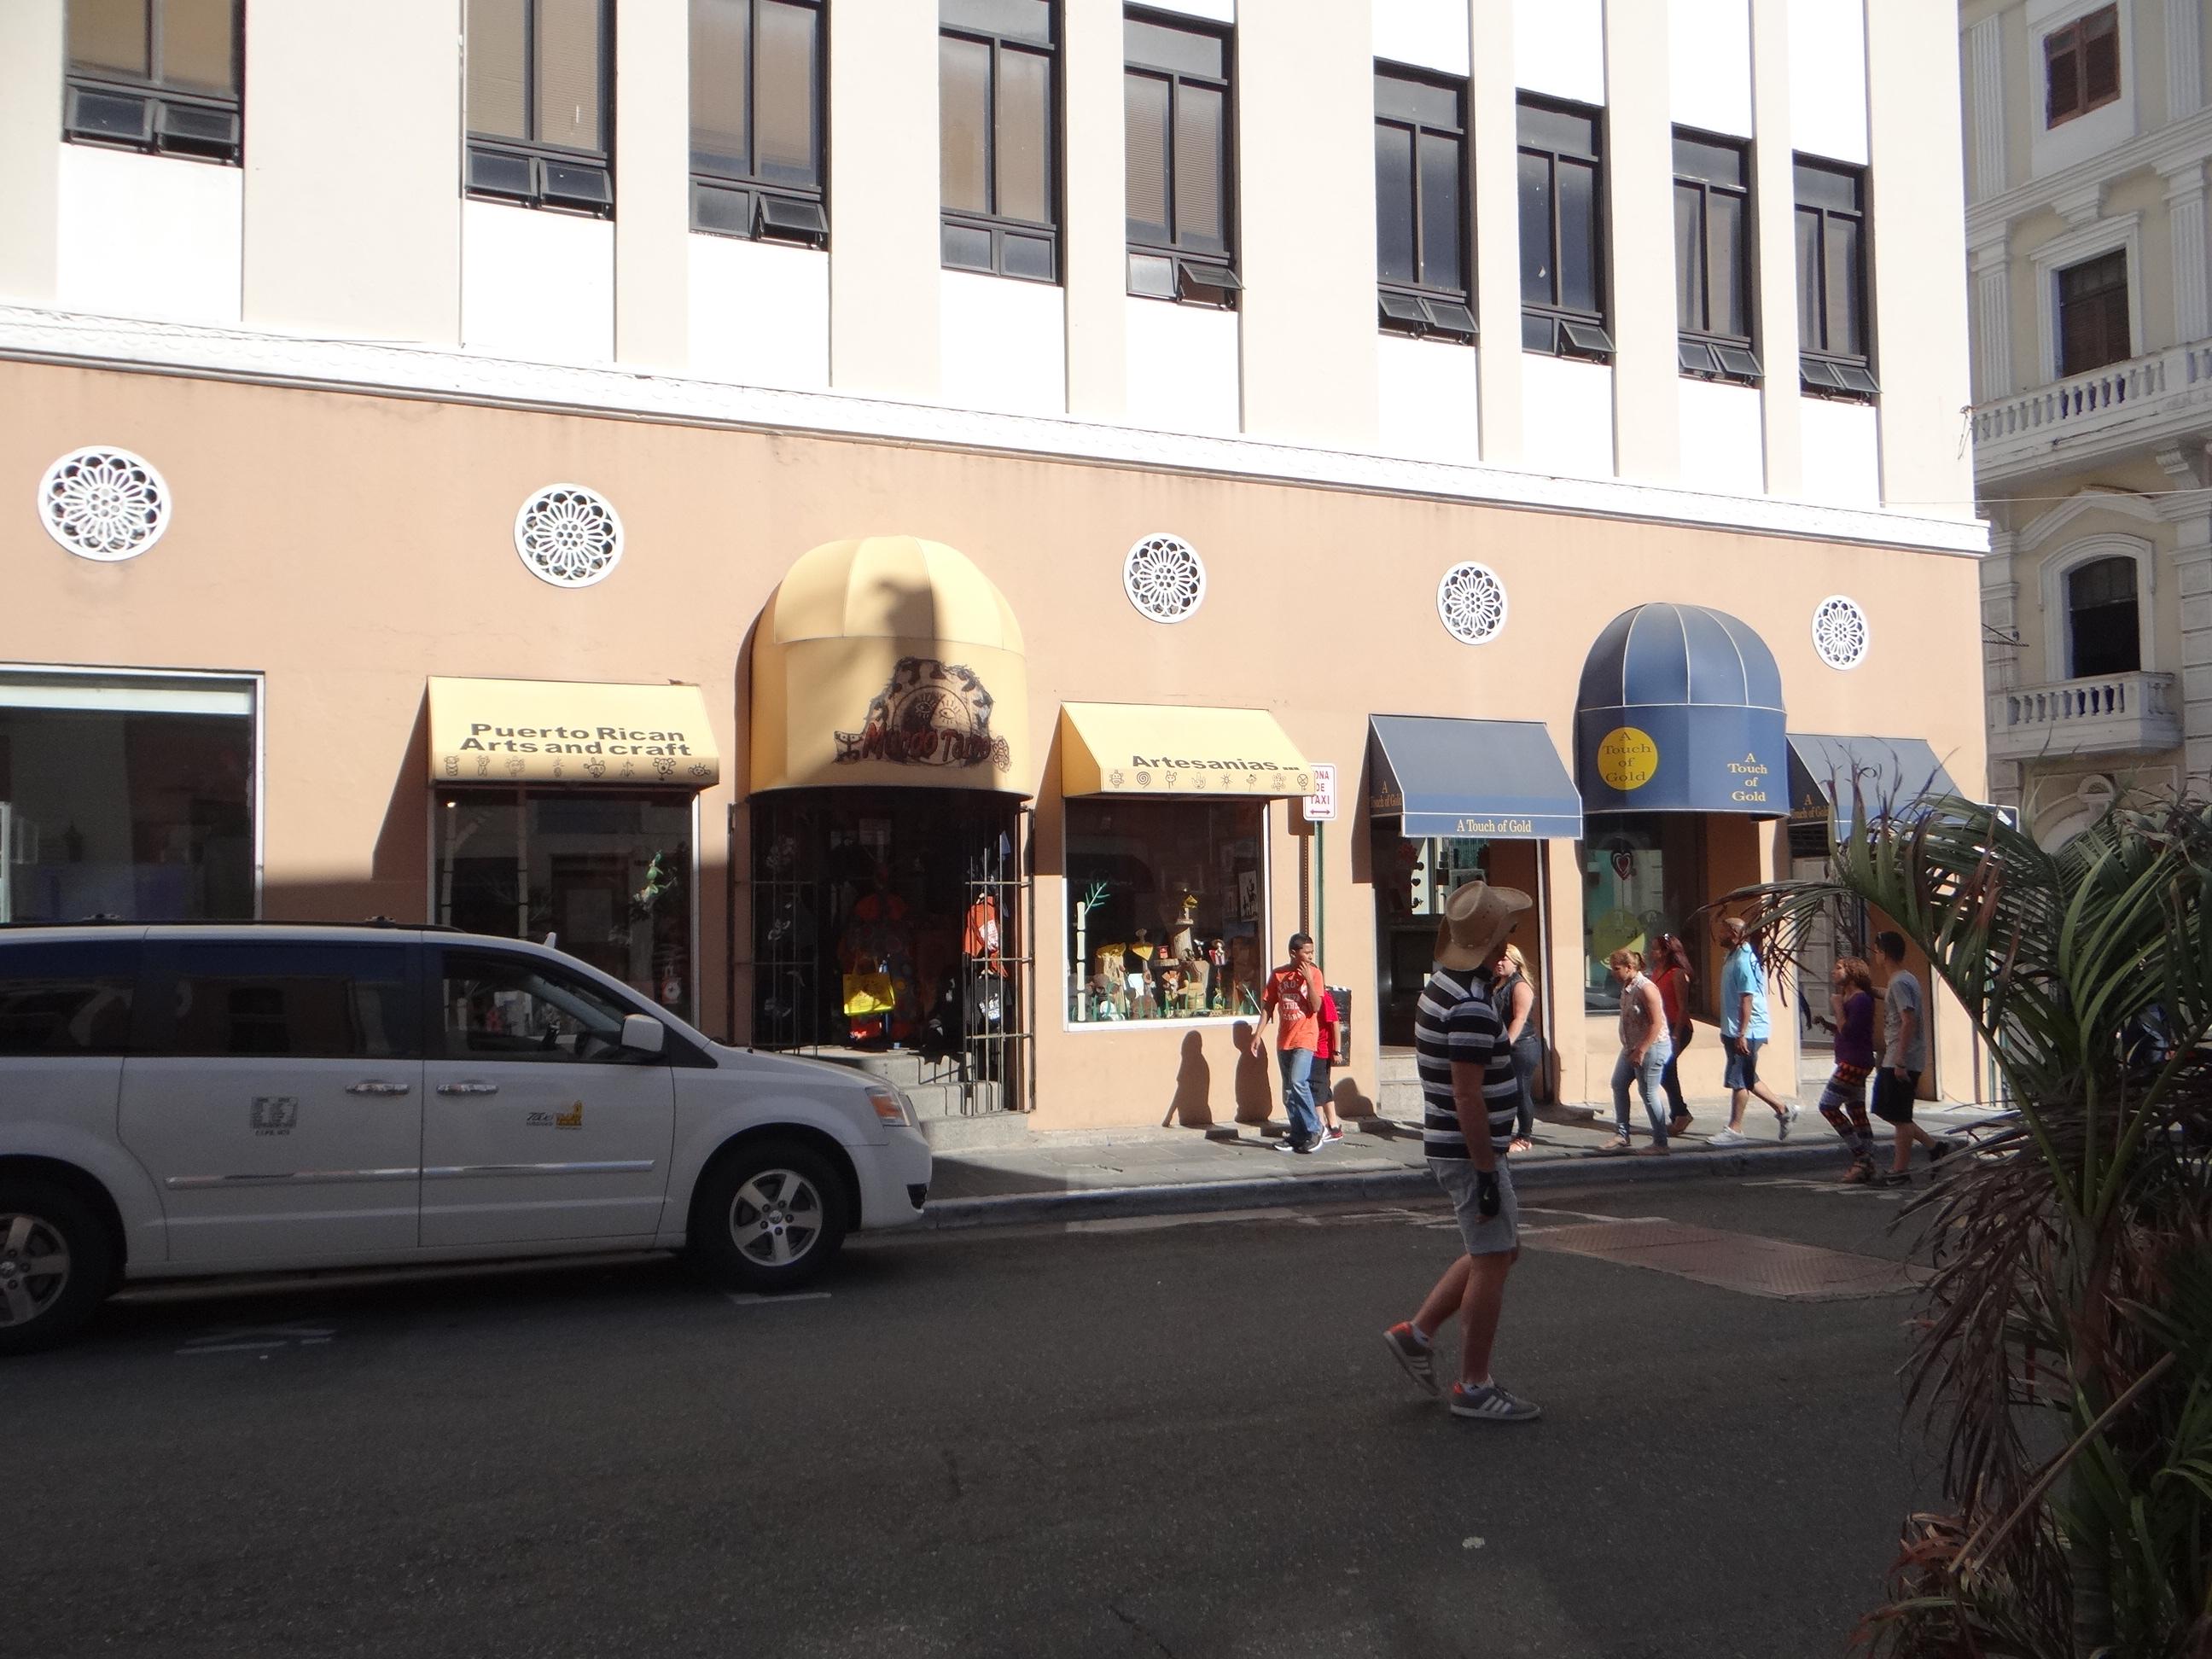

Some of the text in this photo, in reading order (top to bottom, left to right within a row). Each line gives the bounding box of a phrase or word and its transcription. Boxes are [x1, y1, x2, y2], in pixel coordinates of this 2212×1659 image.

[470, 724, 684, 742] Puerto Rican
[1619, 731, 1632, 741] A
[459, 738, 691, 757] Arts and craft
[1604, 744, 1651, 754] Touch
[1618, 757, 1635, 767] of
[1744, 753, 1756, 763] A
[1726, 763, 1767, 774] Touch
[1315, 771, 1330, 780] ONA
[1605, 771, 1646, 783] Gold
[1381, 780, 1388, 794] A
[1744, 777, 1759, 787] of
[1311, 795, 1330, 805] TAXI
[1732, 791, 1767, 802] Gold
[1804, 794, 1813, 806] A
[1457, 819, 1532, 833] A Touch of Gold
